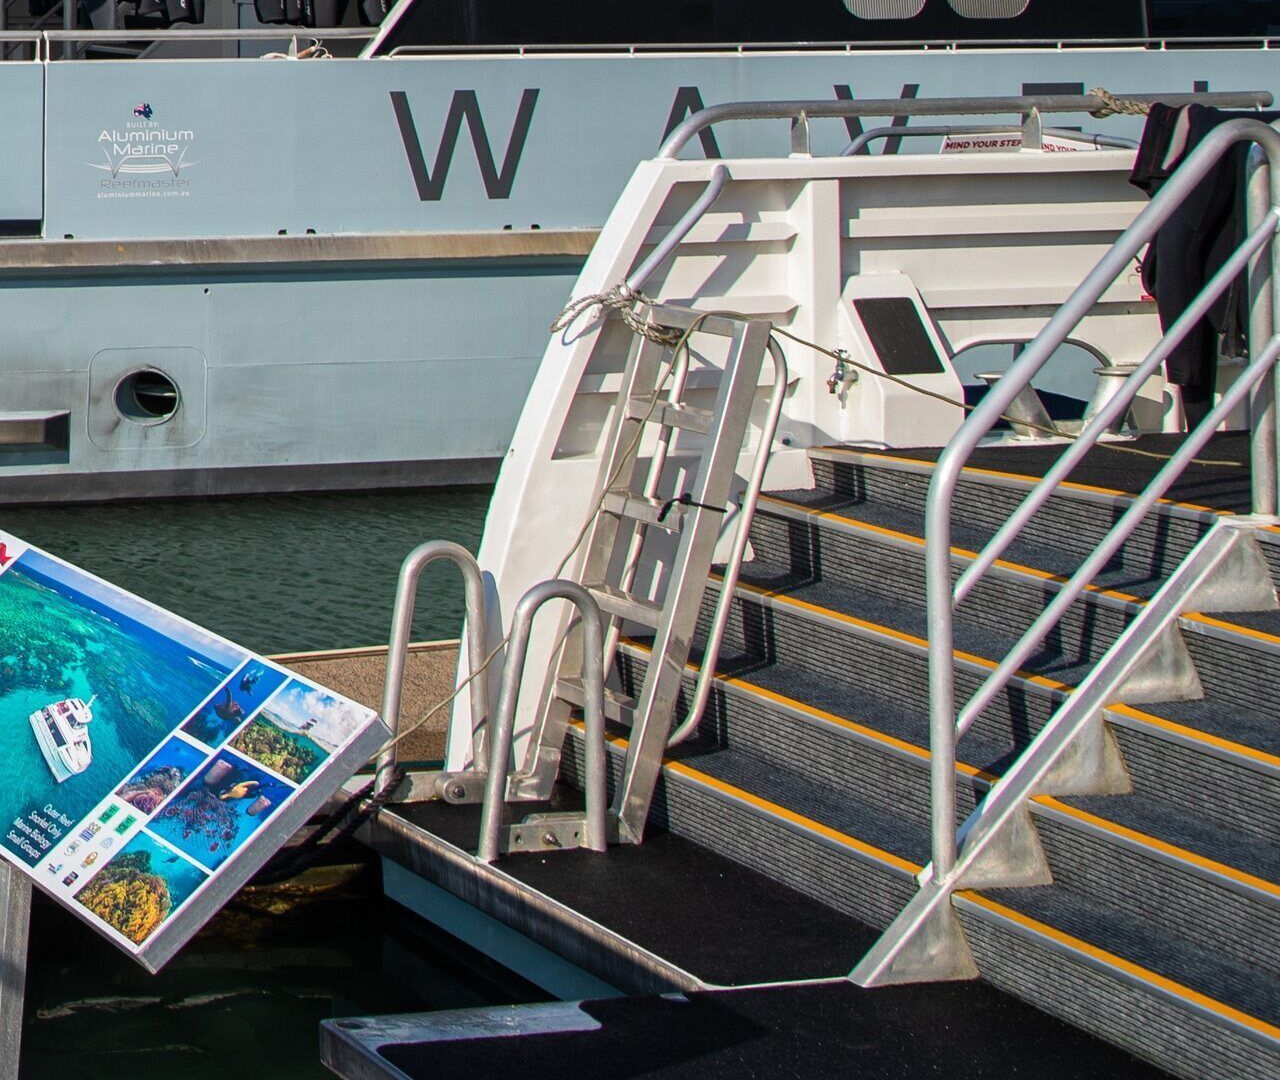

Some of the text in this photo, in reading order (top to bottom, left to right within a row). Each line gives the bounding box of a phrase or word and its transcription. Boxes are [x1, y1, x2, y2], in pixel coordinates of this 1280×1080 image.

[126, 121, 147, 129] BUILT
[98, 129, 194, 142] Aluminium
[113, 143, 179, 155] Marine
[945, 140, 970, 150] MIND
[972, 139, 998, 149] YOUR
[100, 177, 192, 189] Reefmaster
[97, 190, 190, 199] aluminiummarine.com.au
[43, 803, 74, 827] Outer Reef
[28, 810, 63, 839] Snorkel Only
[13, 816, 53, 849] Marine Biology
[6, 829, 42, 860] Small Groups
